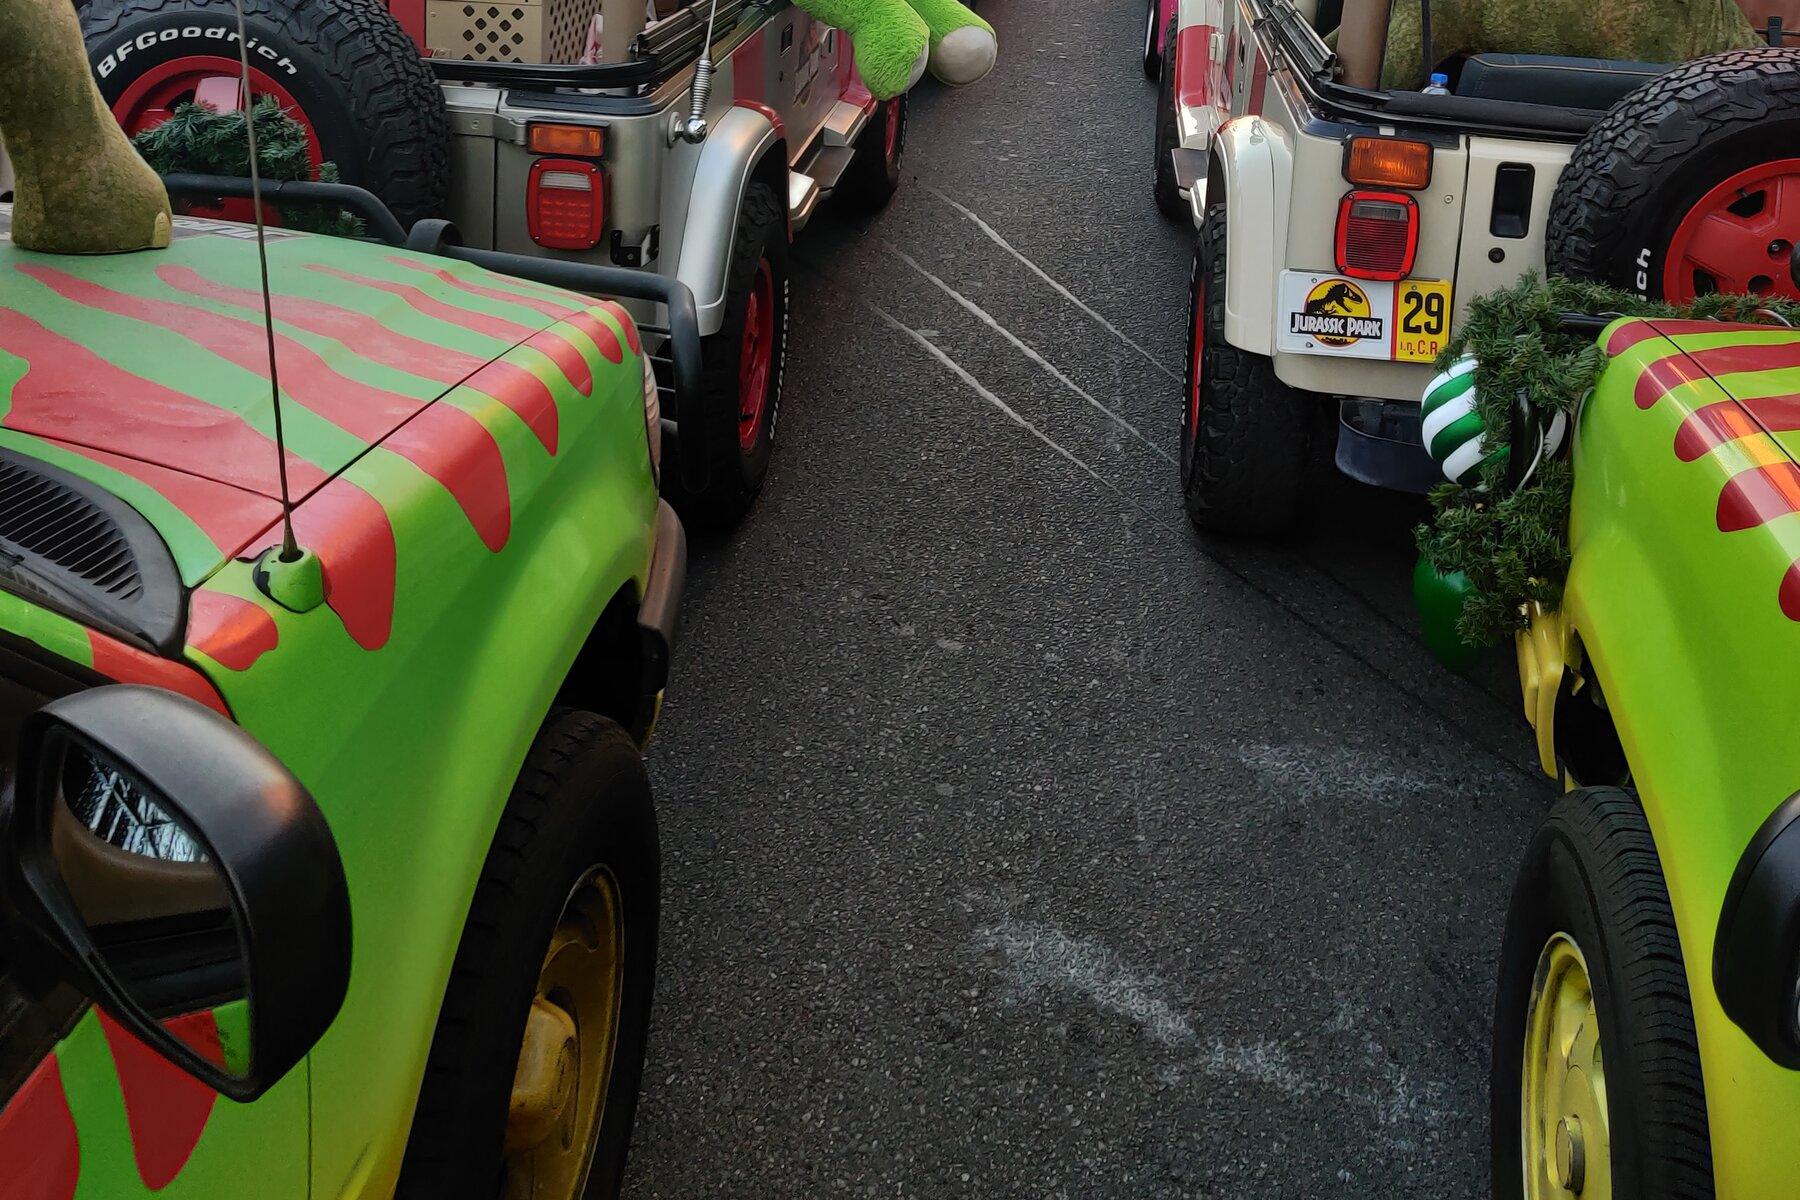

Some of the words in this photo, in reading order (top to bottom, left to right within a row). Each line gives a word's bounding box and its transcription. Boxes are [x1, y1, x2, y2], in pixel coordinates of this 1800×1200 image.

[97, 26, 297, 78] BFGoodrich
[1292, 313, 1345, 334] JURASSIC
[1346, 317, 1381, 337] PARK
[1403, 291, 1444, 335] 29
